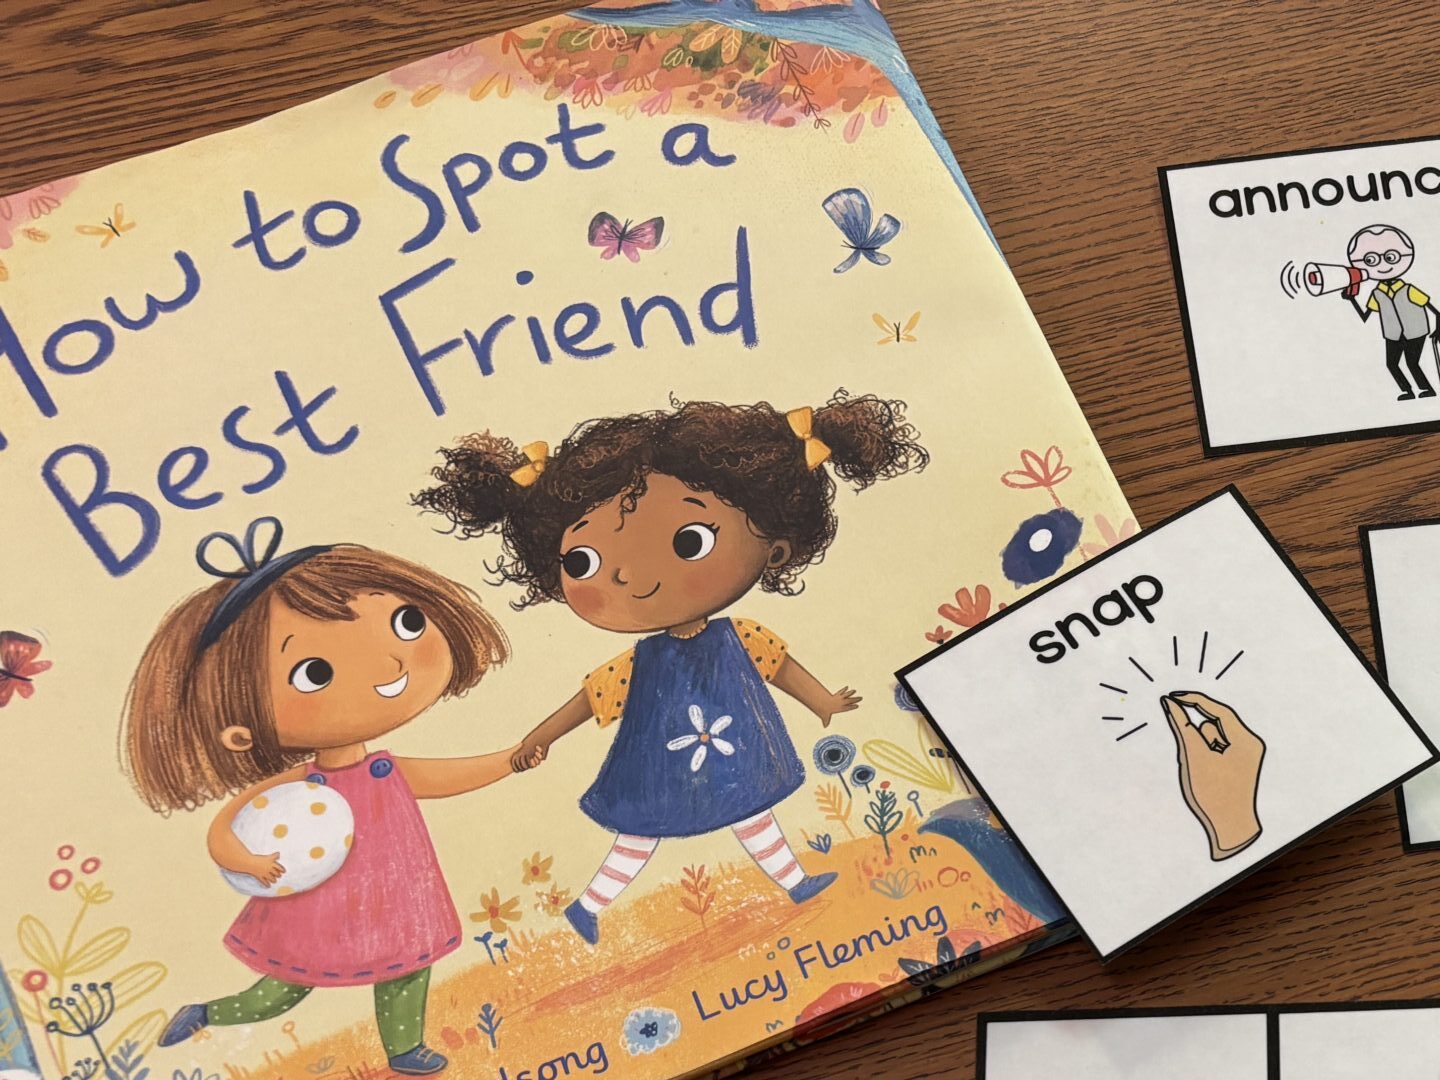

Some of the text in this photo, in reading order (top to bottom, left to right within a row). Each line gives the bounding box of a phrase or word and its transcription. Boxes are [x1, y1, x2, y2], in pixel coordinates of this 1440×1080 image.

[232, 189, 361, 271] to
[380, 103, 614, 253] Spot
[662, 121, 736, 167] a
[41, 225, 759, 578] Best Friend
[1029, 571, 1164, 665] snap
[691, 904, 949, 1021] Lucy Fleming
